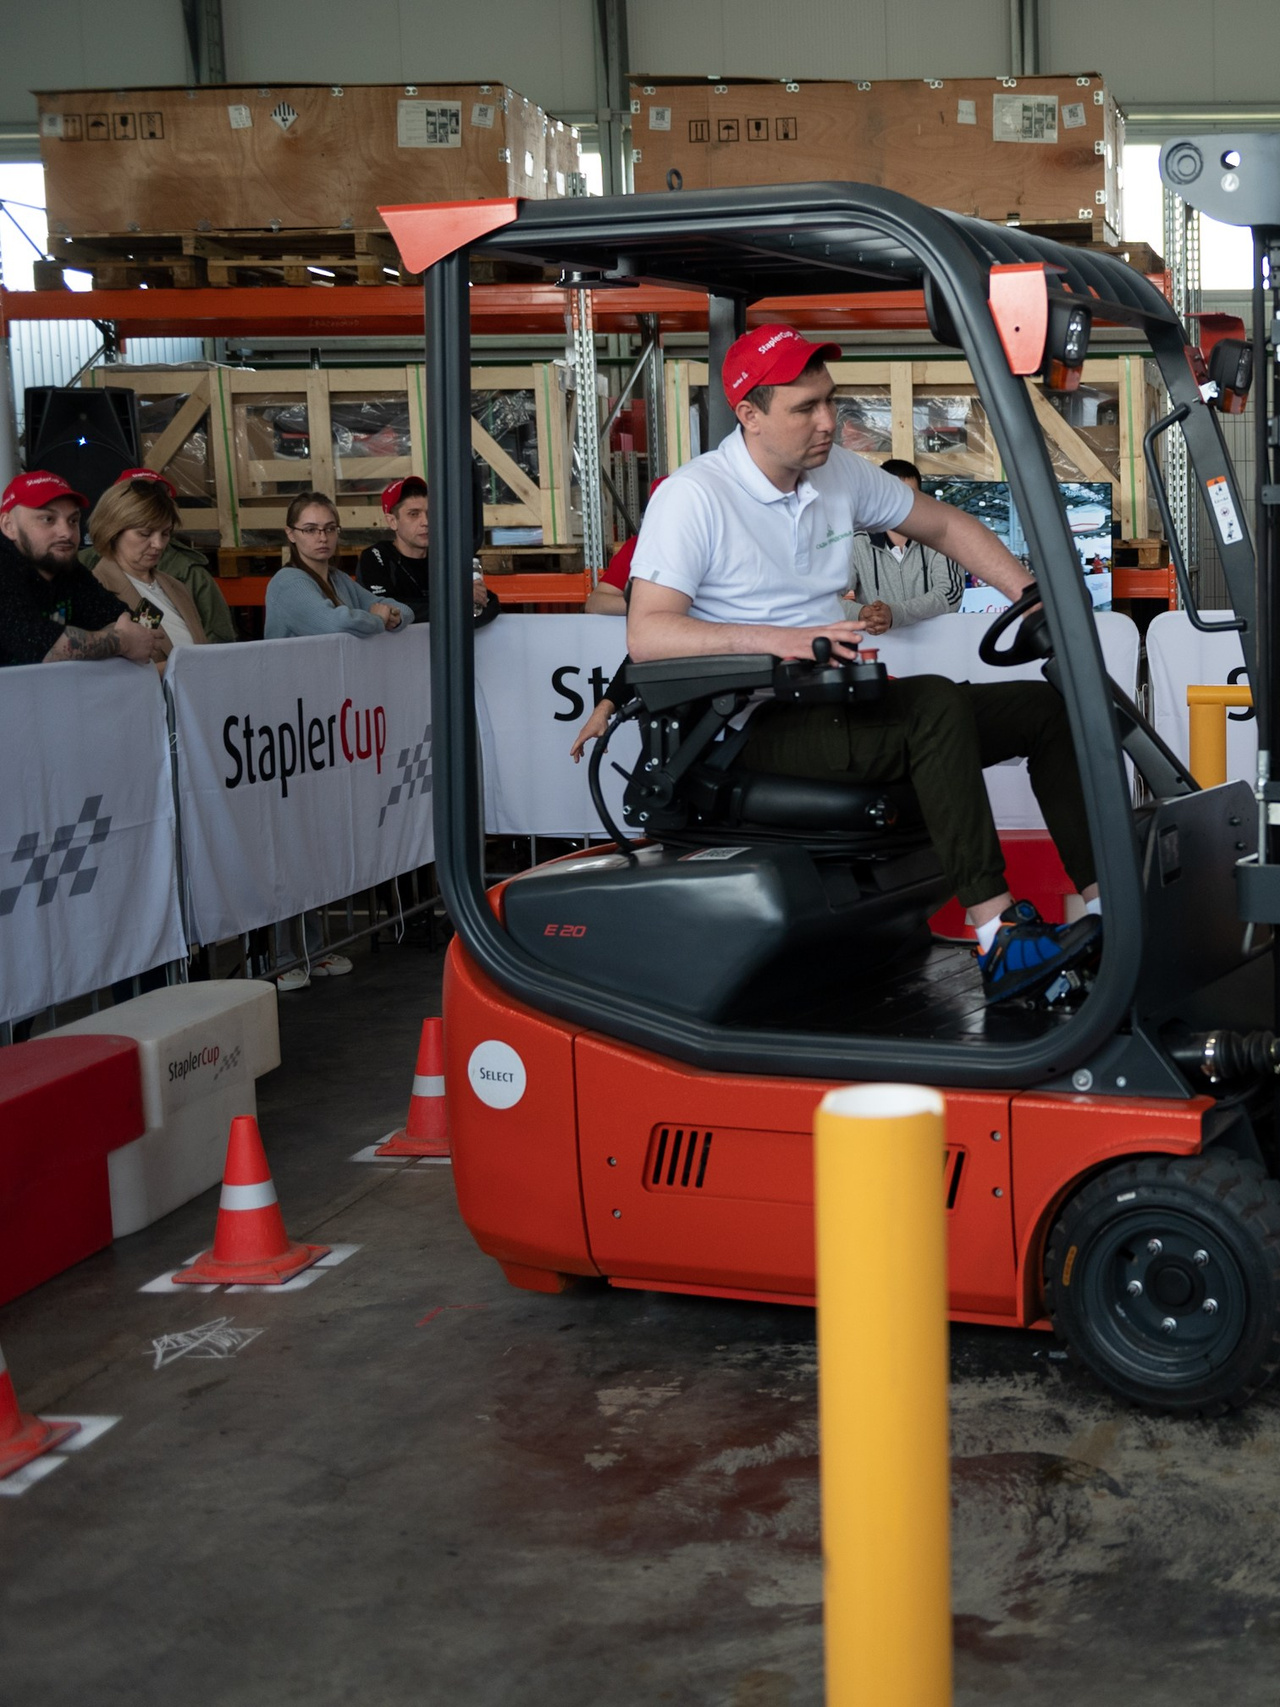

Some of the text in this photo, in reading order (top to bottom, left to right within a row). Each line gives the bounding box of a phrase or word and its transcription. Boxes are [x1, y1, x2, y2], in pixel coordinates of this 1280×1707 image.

[758, 331, 793, 354] StaplerCup
[223, 698, 386, 798] StaplerCup
[543, 924, 587, 938] E 20
[168, 1046, 220, 1081] StaplerCup
